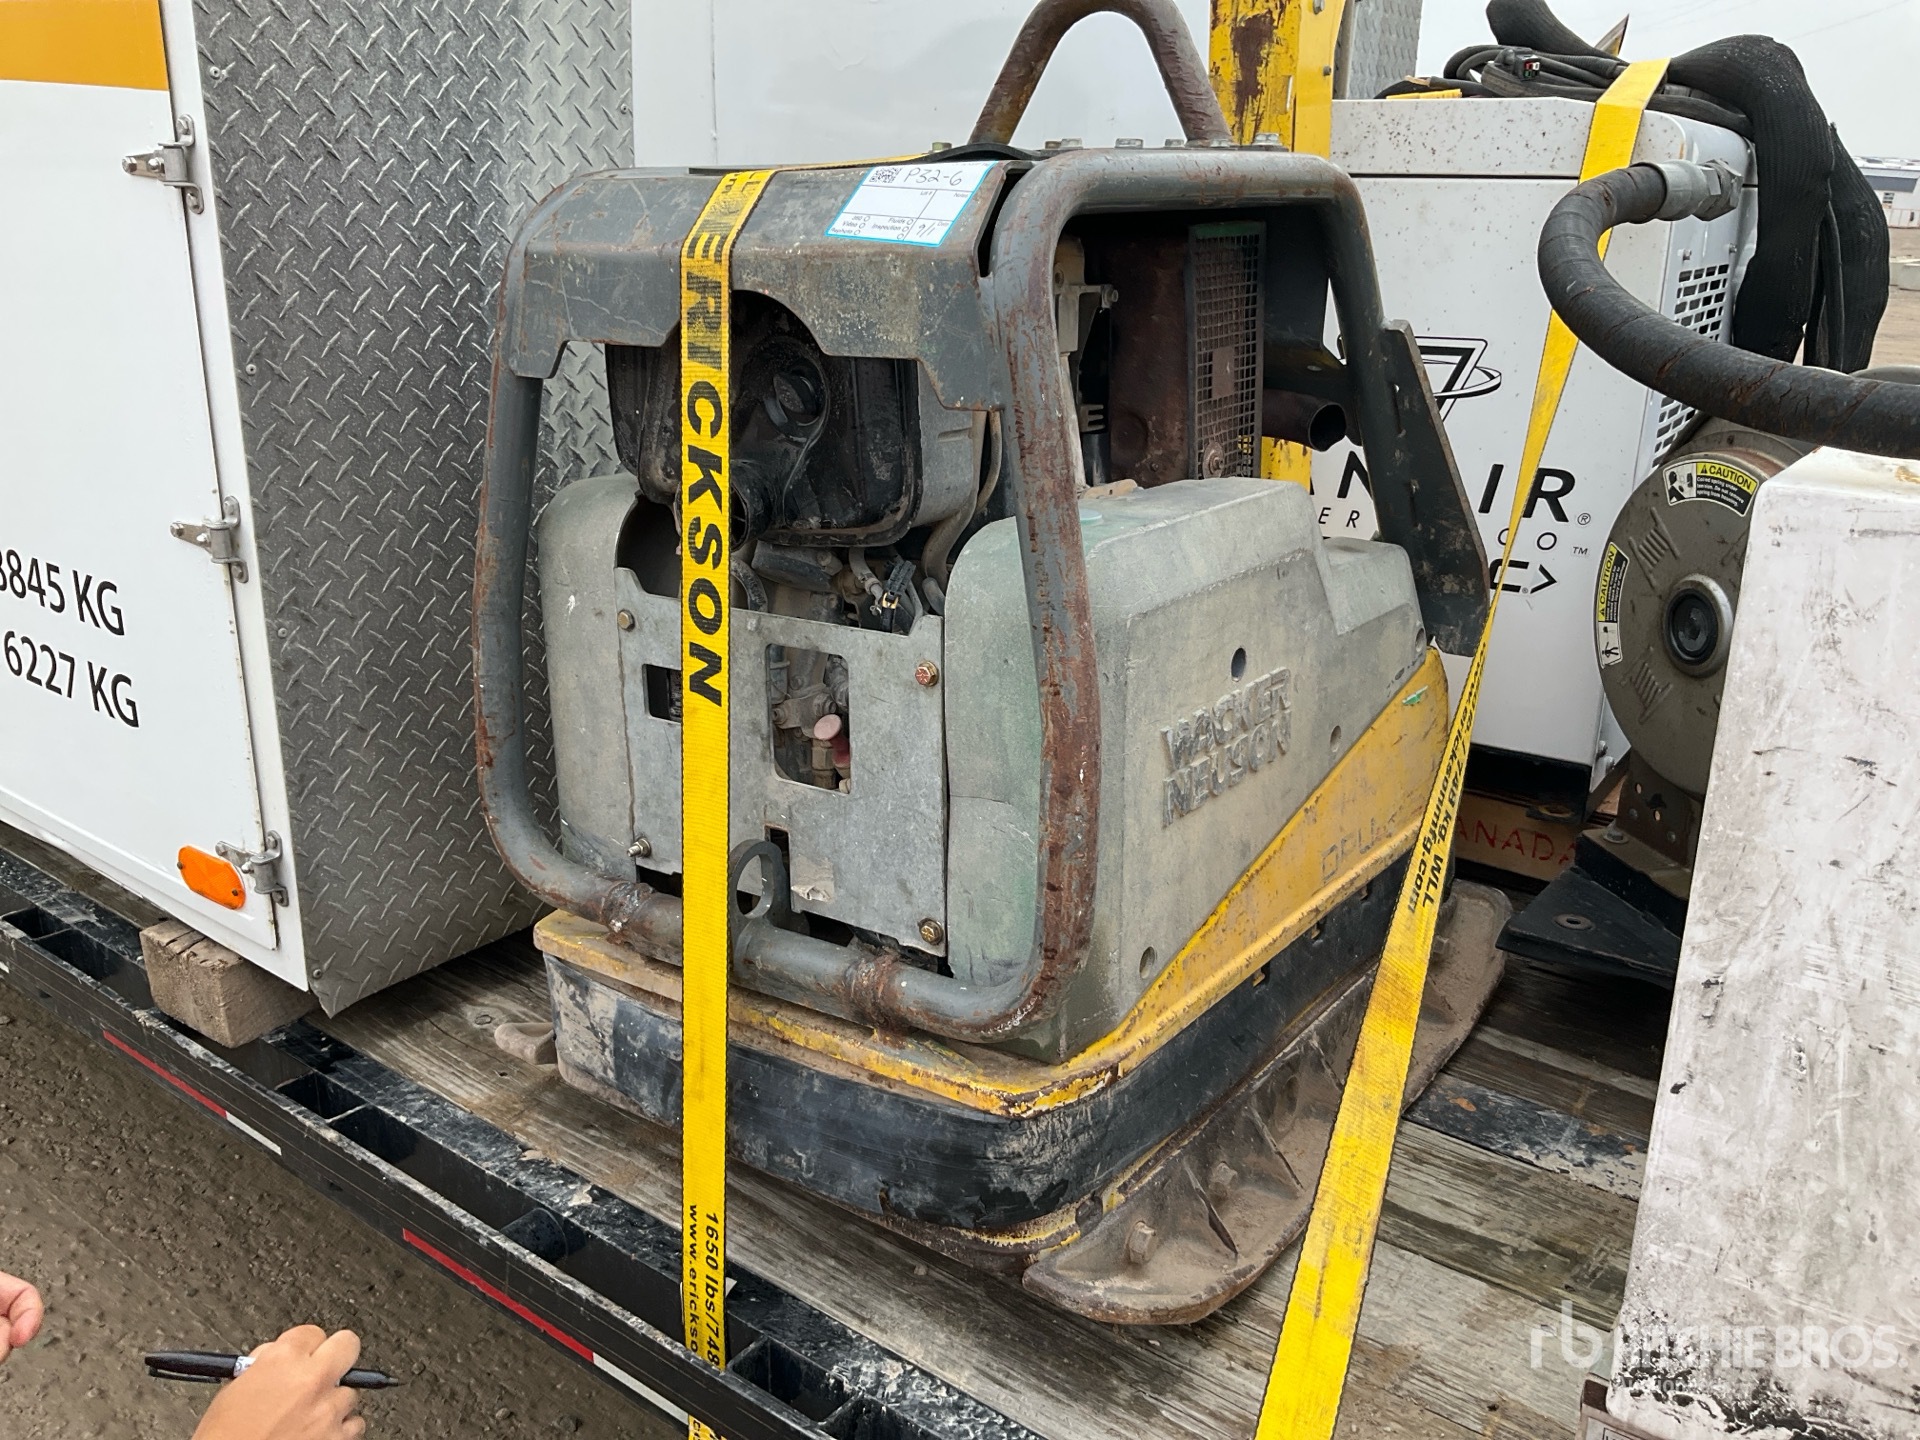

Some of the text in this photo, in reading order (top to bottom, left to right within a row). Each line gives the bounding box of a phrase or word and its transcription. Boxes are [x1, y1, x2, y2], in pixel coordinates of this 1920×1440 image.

[904, 167, 963, 187] P32-6
[686, 218, 736, 707] ERICKSON
[1709, 465, 1752, 490] CAUTION
[72, 569, 125, 636] KG
[1600, 551, 1615, 604] CAUTION
[4, 630, 139, 728] 6227 KG
[1422, 853, 1444, 908] WLL
[705, 1211, 719, 1271] 1650
